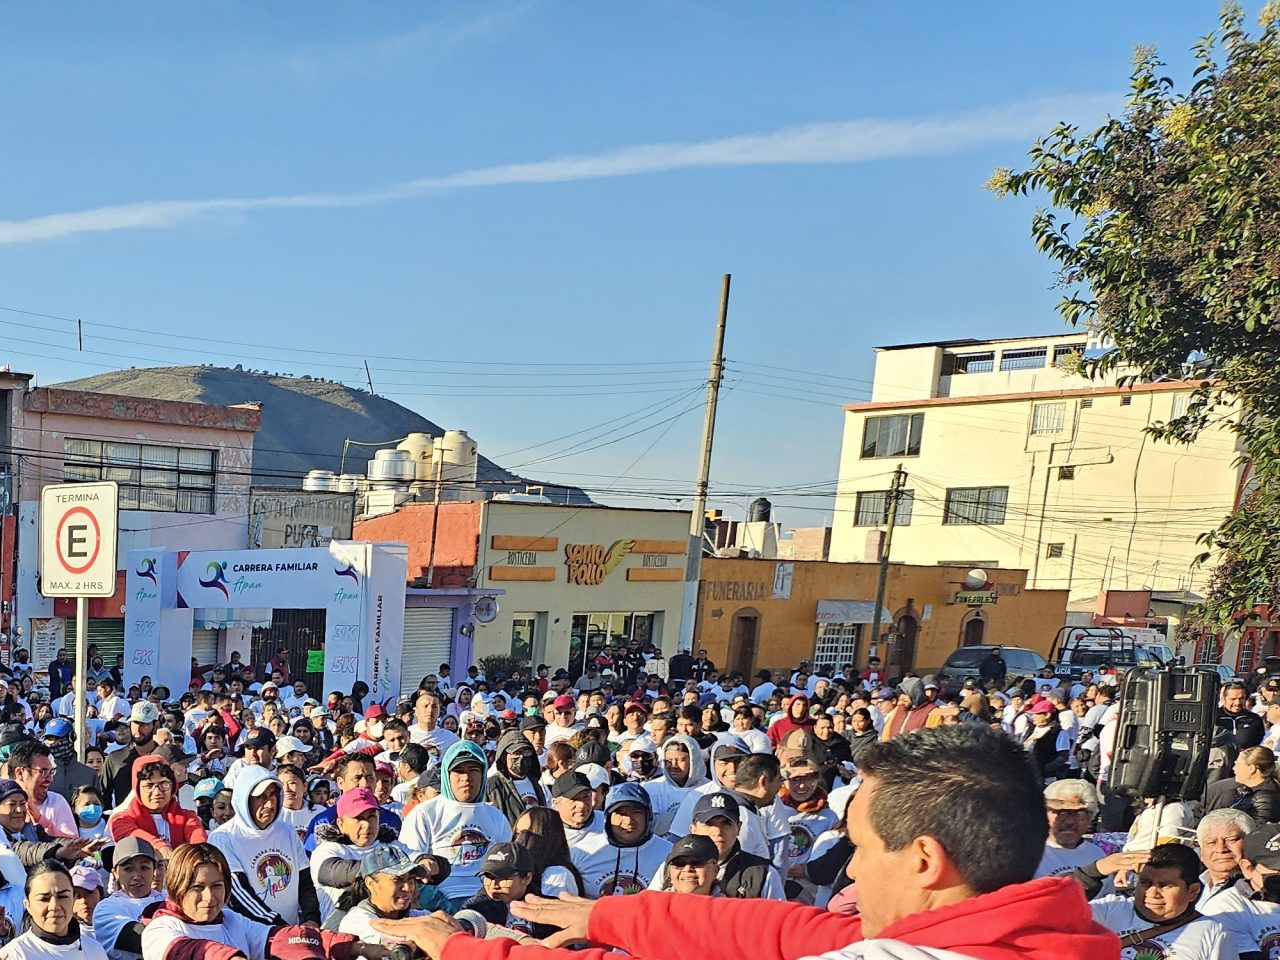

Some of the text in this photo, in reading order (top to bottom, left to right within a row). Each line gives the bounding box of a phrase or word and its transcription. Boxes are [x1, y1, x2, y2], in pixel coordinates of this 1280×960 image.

[56, 493, 99, 503] TERMINA
[68, 525, 87, 557] E
[233, 562, 319, 573] CARRERA FAMILIAR
[50, 581, 103, 590] MAX. 2 HRS
[233, 575, 263, 594] Apan
[135, 587, 157, 602] Apan
[333, 587, 359, 604] Apan
[375, 595, 383, 643] FAMILIAR
[132, 649, 153, 665] 5K
[331, 656, 357, 673] 5K
[373, 646, 381, 694] CARRERA
[1173, 710, 1195, 723] JBL
[288, 937, 319, 946] HIDALGO
